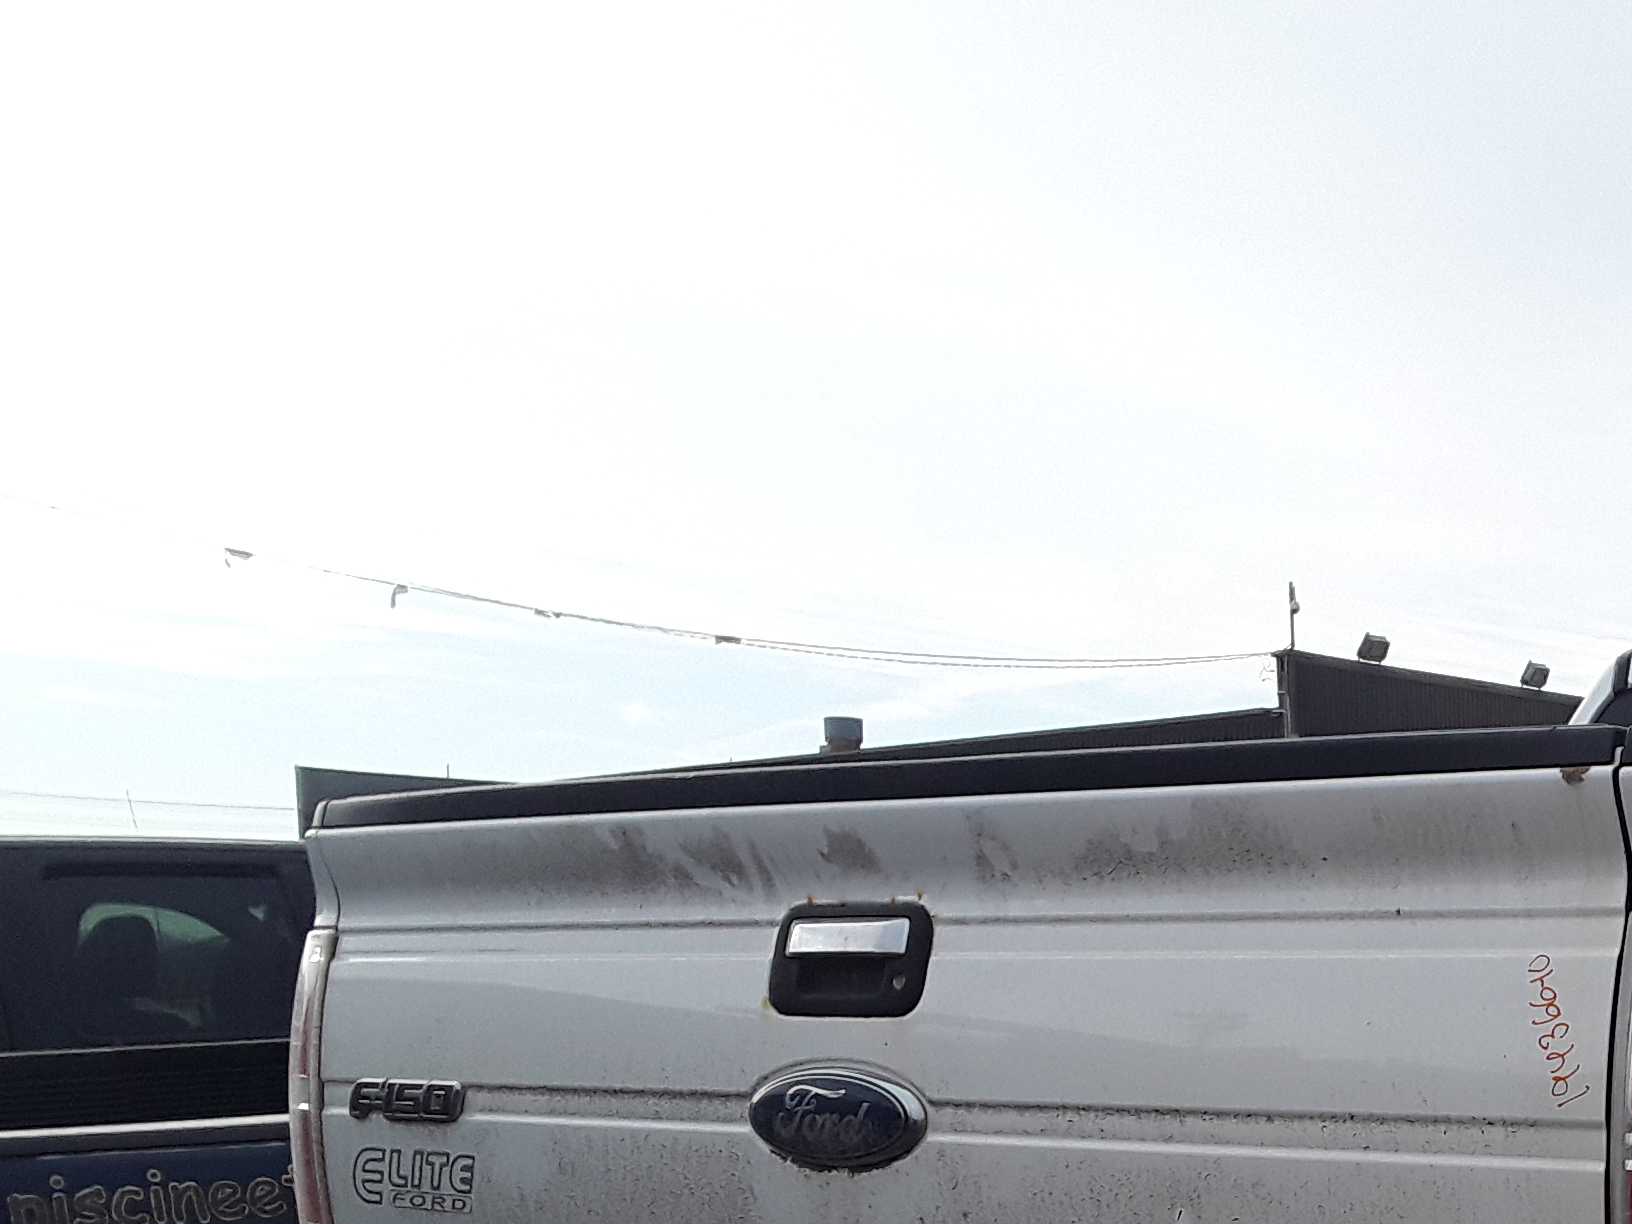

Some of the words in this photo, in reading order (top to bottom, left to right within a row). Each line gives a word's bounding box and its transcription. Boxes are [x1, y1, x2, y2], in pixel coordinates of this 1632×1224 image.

[772, 1083, 879, 1146] Ford
[353, 1147, 476, 1206] ELITE
[391, 1191, 468, 1211] FORD
